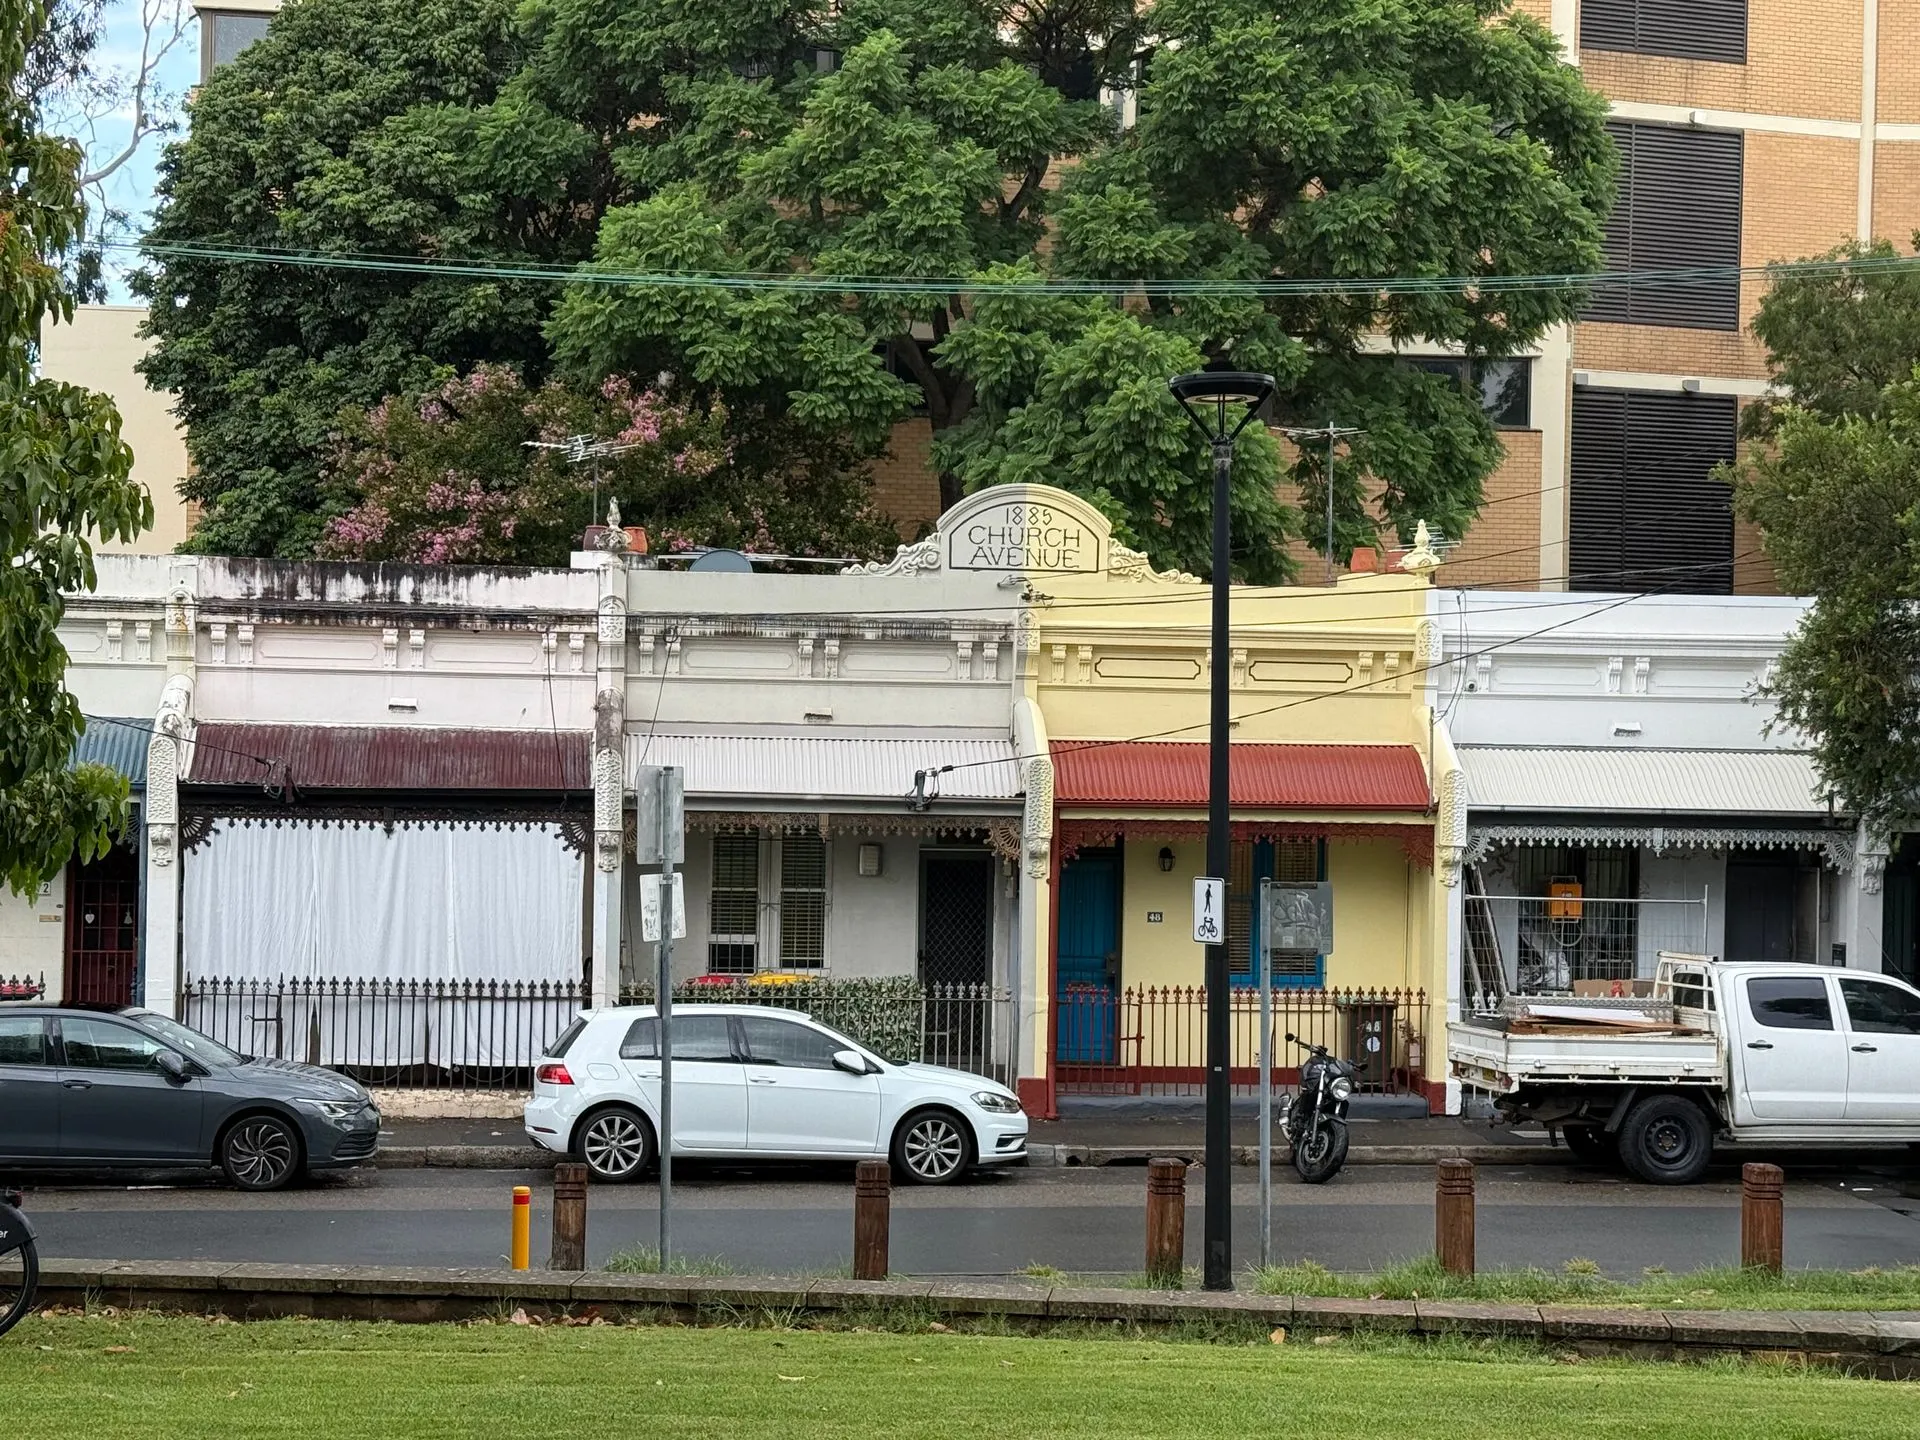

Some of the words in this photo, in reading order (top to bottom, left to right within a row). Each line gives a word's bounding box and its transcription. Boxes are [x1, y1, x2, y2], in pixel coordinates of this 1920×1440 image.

[1006, 505, 1053, 526] 1885
[968, 525, 1081, 548] CHURCH
[968, 546, 1081, 569] AVENUE
[1149, 913, 1161, 922] 48
